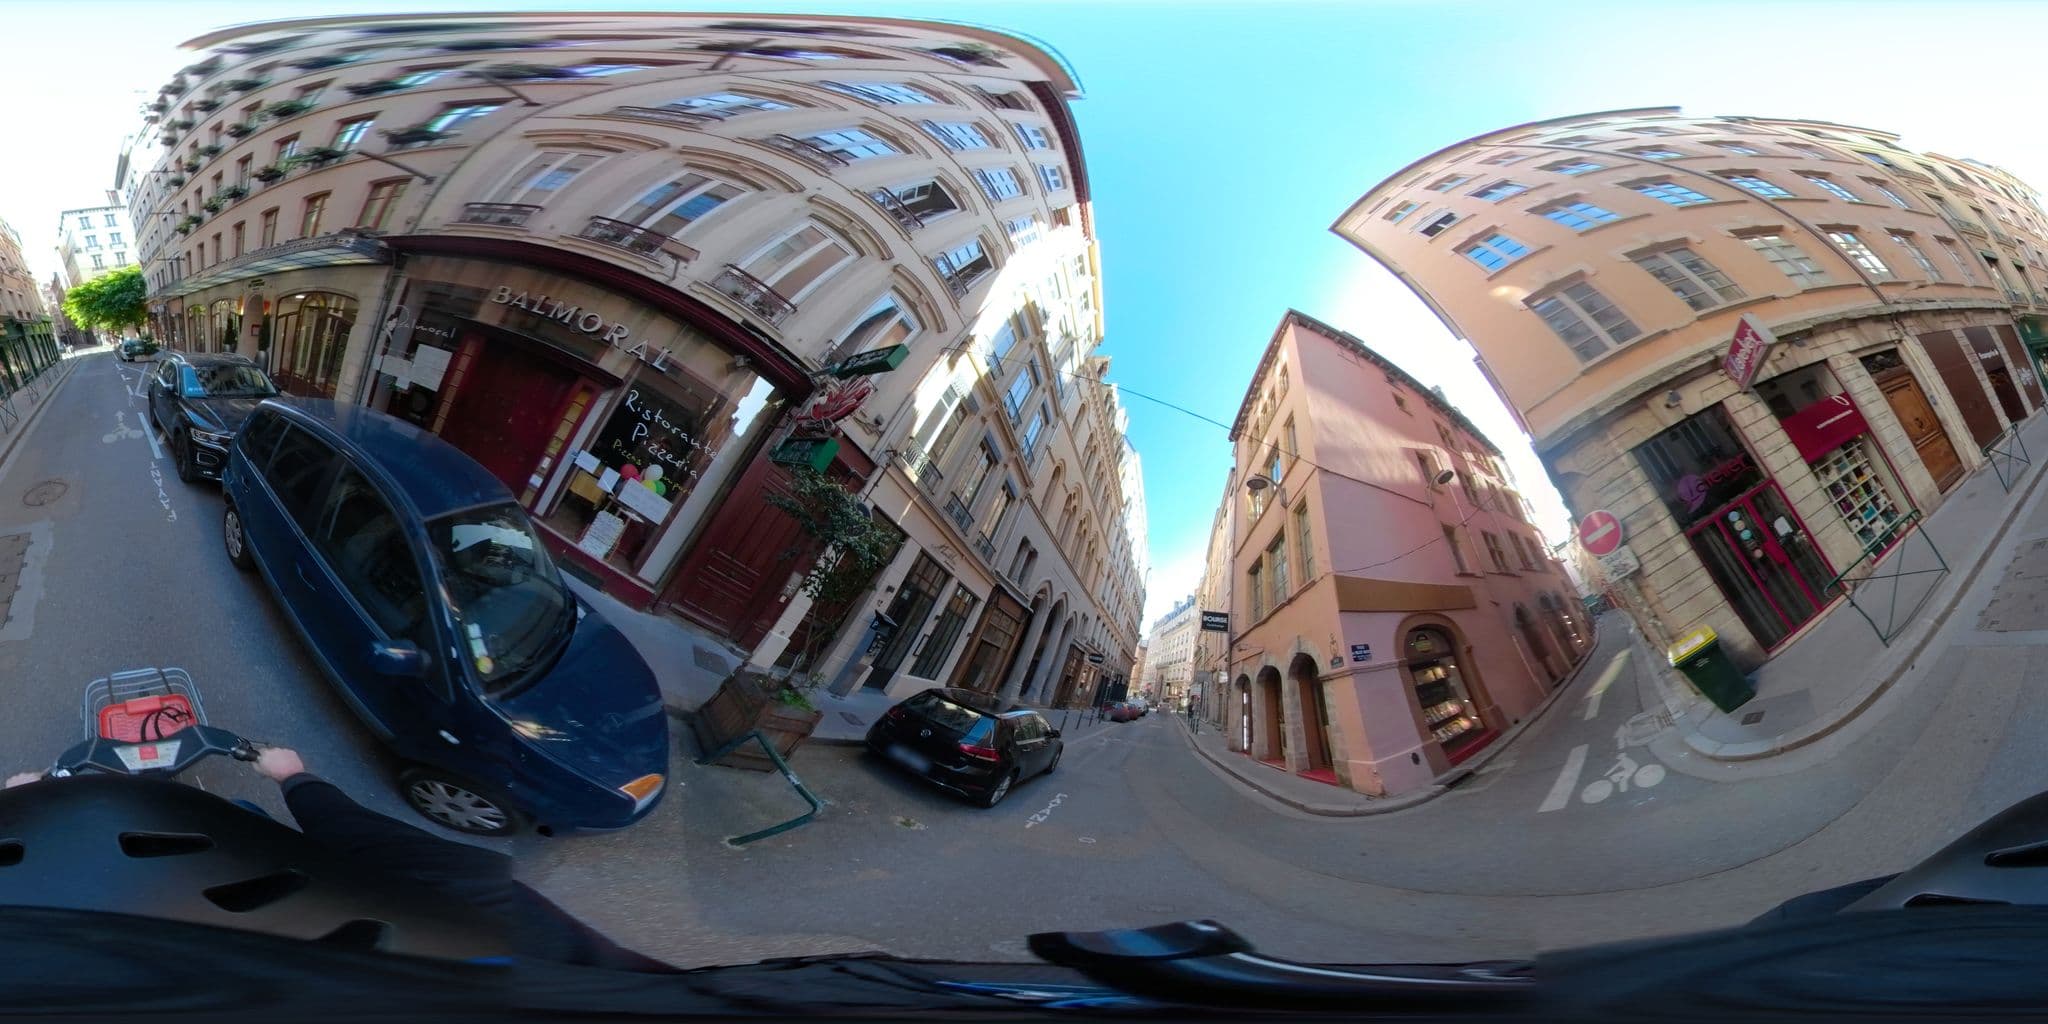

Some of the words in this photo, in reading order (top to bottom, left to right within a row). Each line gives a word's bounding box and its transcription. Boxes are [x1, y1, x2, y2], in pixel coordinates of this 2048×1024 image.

[491, 285, 672, 372] BALMORAL
[625, 389, 718, 459] Ristorante
[631, 422, 698, 480] Pizzeria
